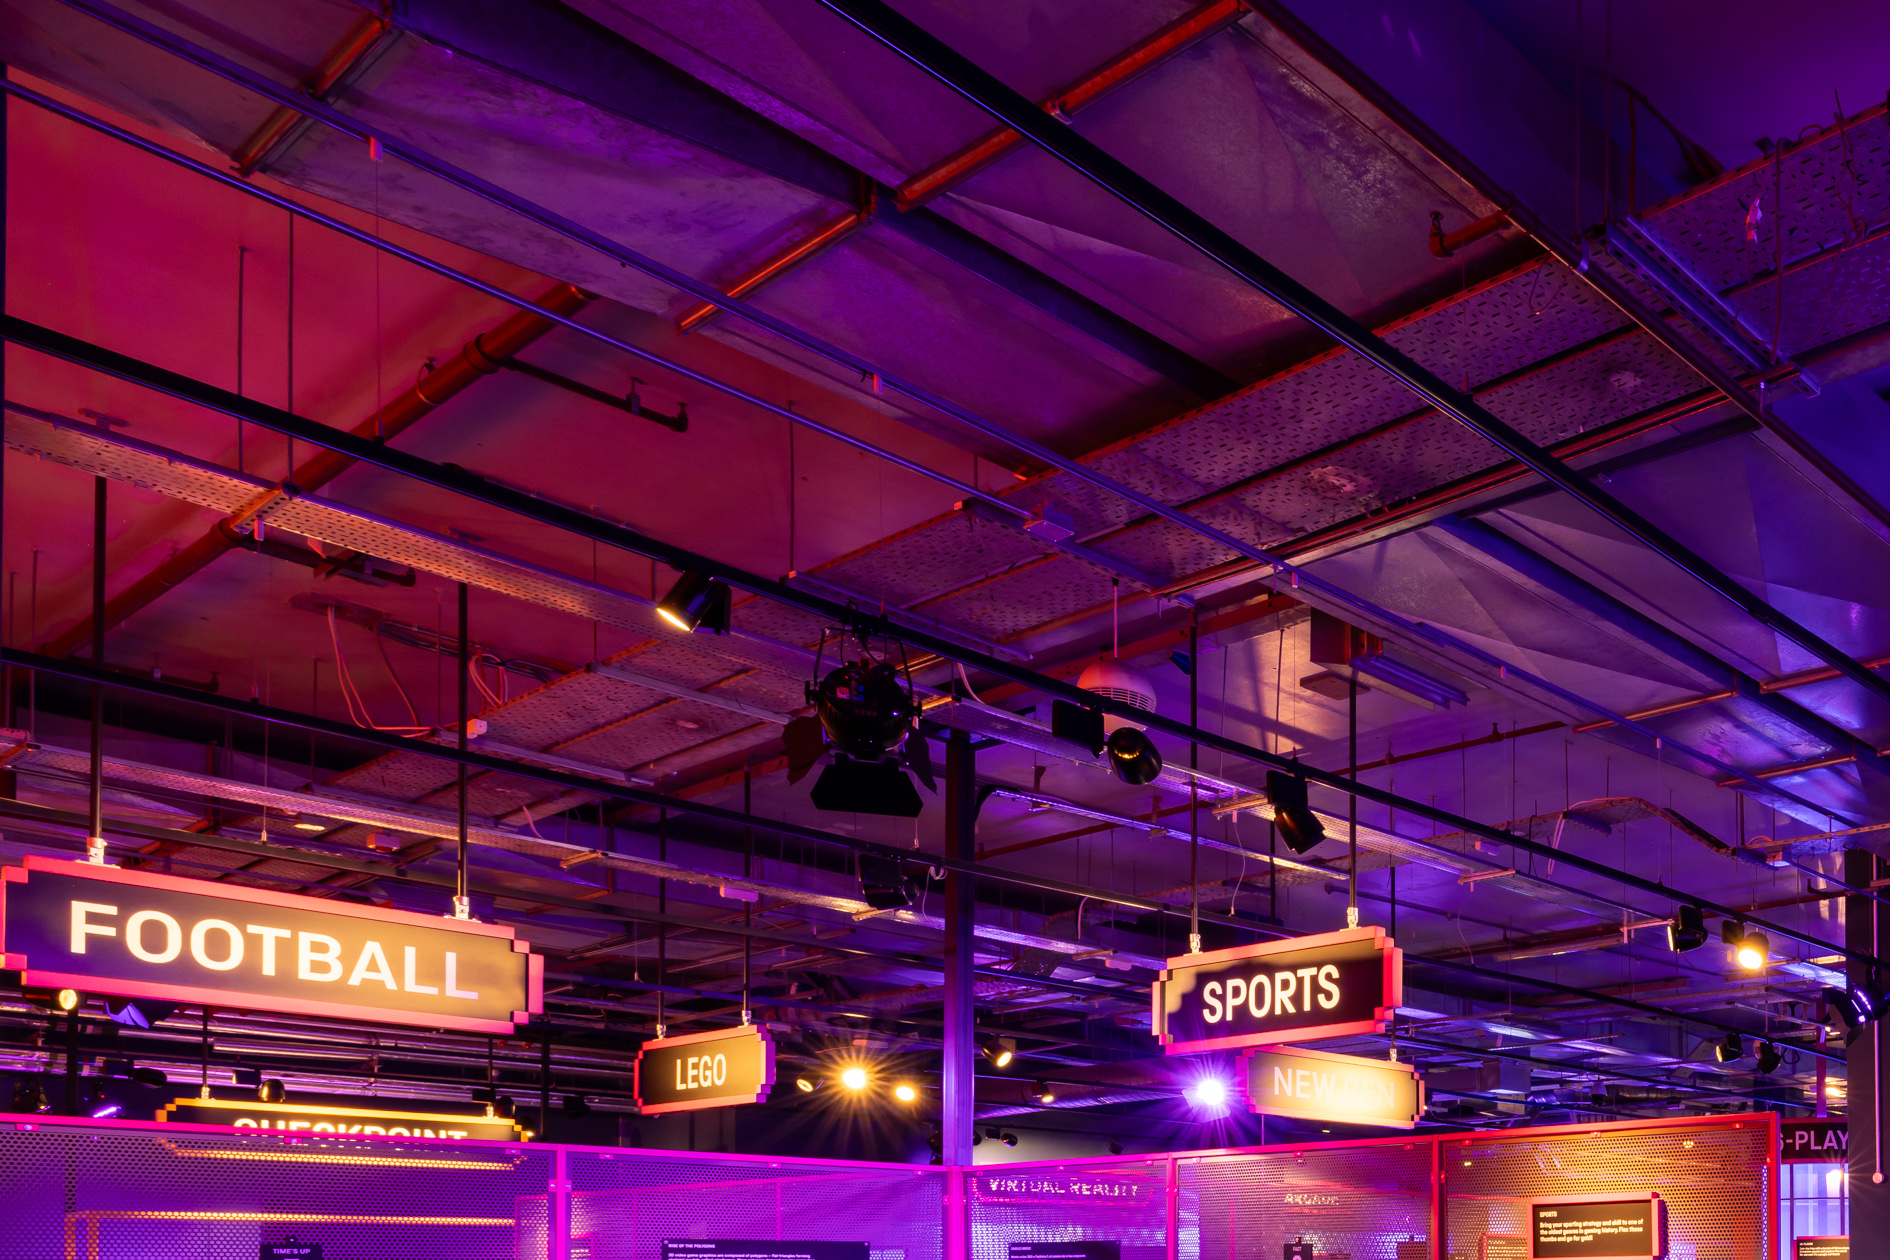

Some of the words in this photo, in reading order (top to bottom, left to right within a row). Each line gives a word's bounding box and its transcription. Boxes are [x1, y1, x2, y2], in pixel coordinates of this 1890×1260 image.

[70, 900, 479, 1000] FOOTBALL
[1202, 964, 1340, 1025] SPORTS
[675, 1053, 727, 1091] LEGO
[1274, 1066, 1336, 1099] NEW
[1343, 1078, 1395, 1109] GEN
